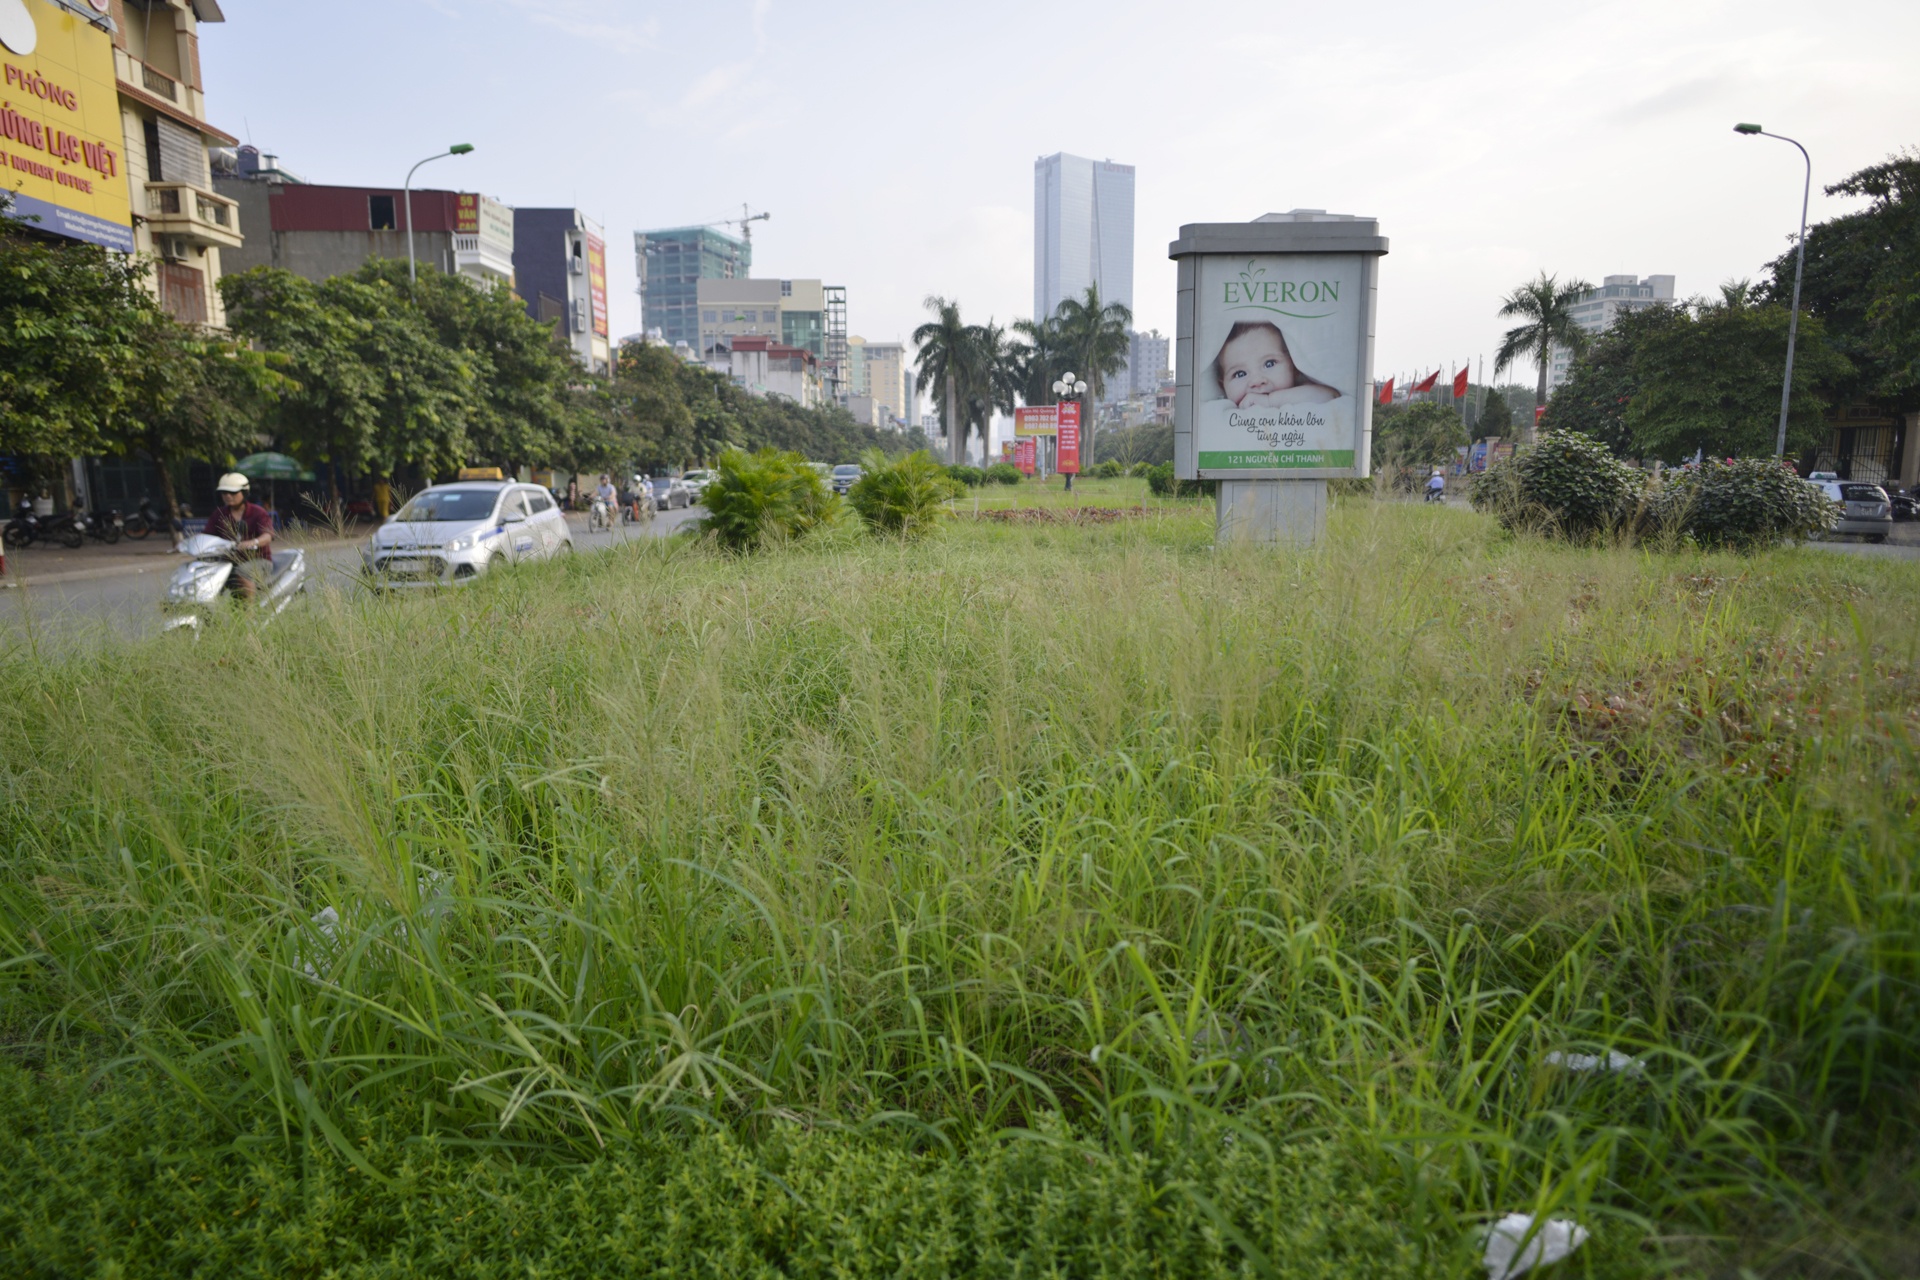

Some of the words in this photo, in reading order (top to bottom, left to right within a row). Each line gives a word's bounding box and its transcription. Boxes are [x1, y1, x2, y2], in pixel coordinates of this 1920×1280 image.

[4, 63, 78, 112] PHÒNG
[45, 126, 81, 165] LẠC
[81, 140, 117, 180] VIỆT
[11, 154, 55, 182] NOTARY
[56, 170, 93, 195] OFFICE
[1223, 280, 1340, 303] EVERON
[1229, 412, 1259, 433] Cùng
[1258, 417, 1277, 426] con
[1278, 412, 1304, 426] khôn
[1281, 429, 1307, 447] ngày
[1228, 455, 1243, 464] 121
[1245, 450, 1279, 463] NGUYỄN
[1280, 453, 1294, 463] CHÍ
[1295, 454, 1325, 463] THANH
